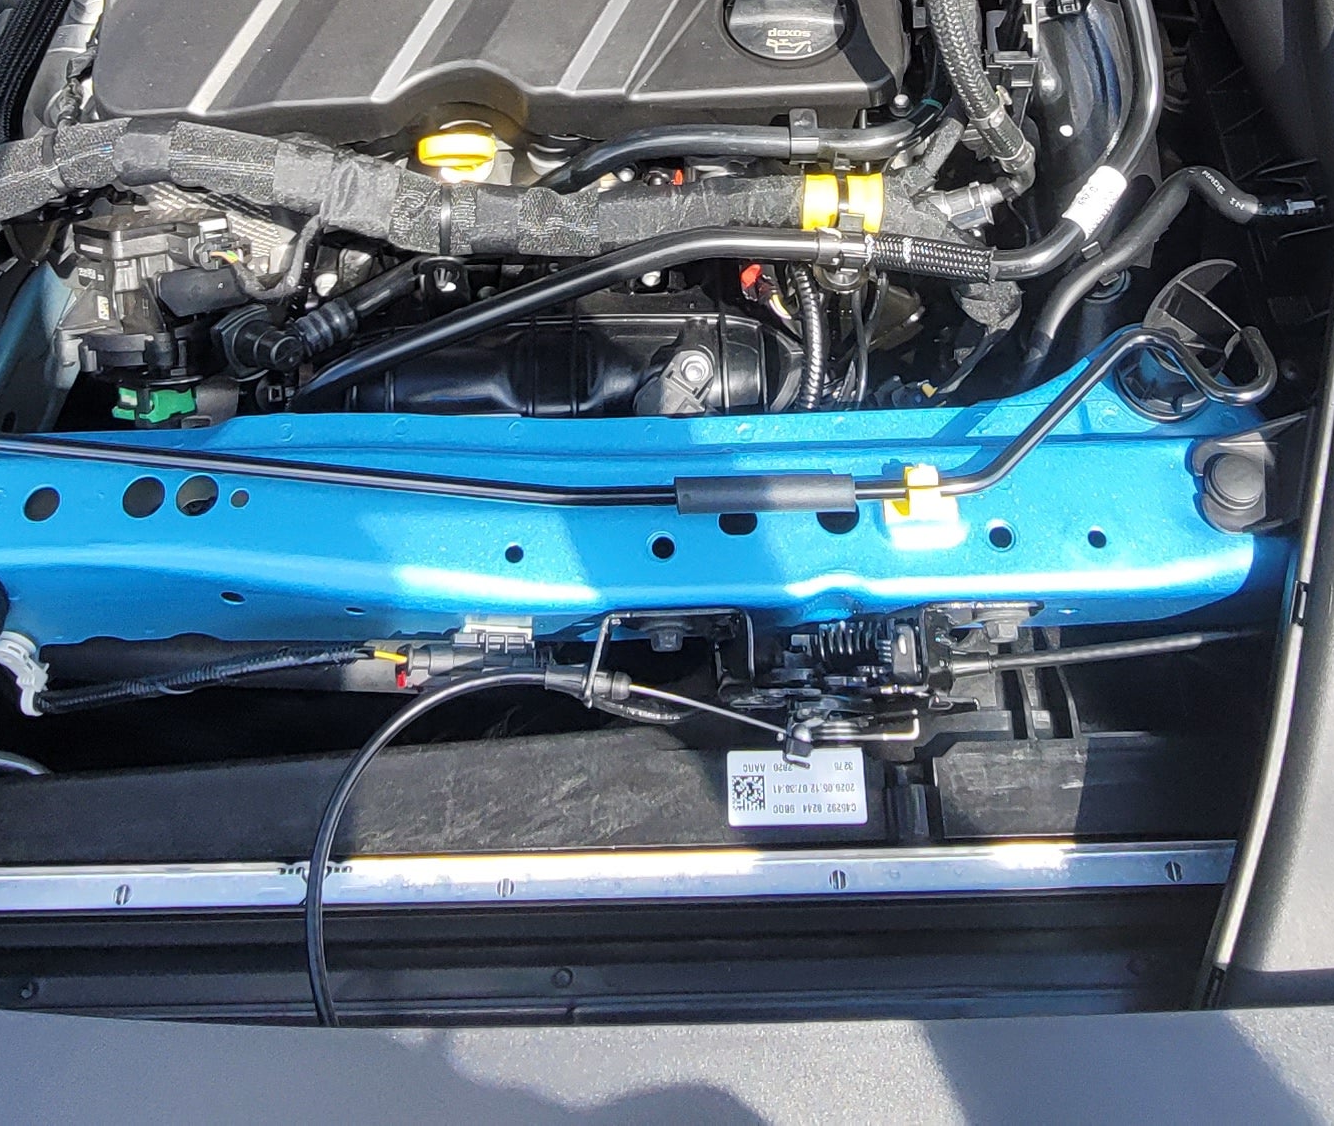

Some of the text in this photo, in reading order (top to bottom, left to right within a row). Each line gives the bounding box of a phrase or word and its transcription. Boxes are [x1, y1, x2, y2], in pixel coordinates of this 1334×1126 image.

[767, 28, 812, 38] dexos
[1202, 170, 1245, 211] MADE IN
